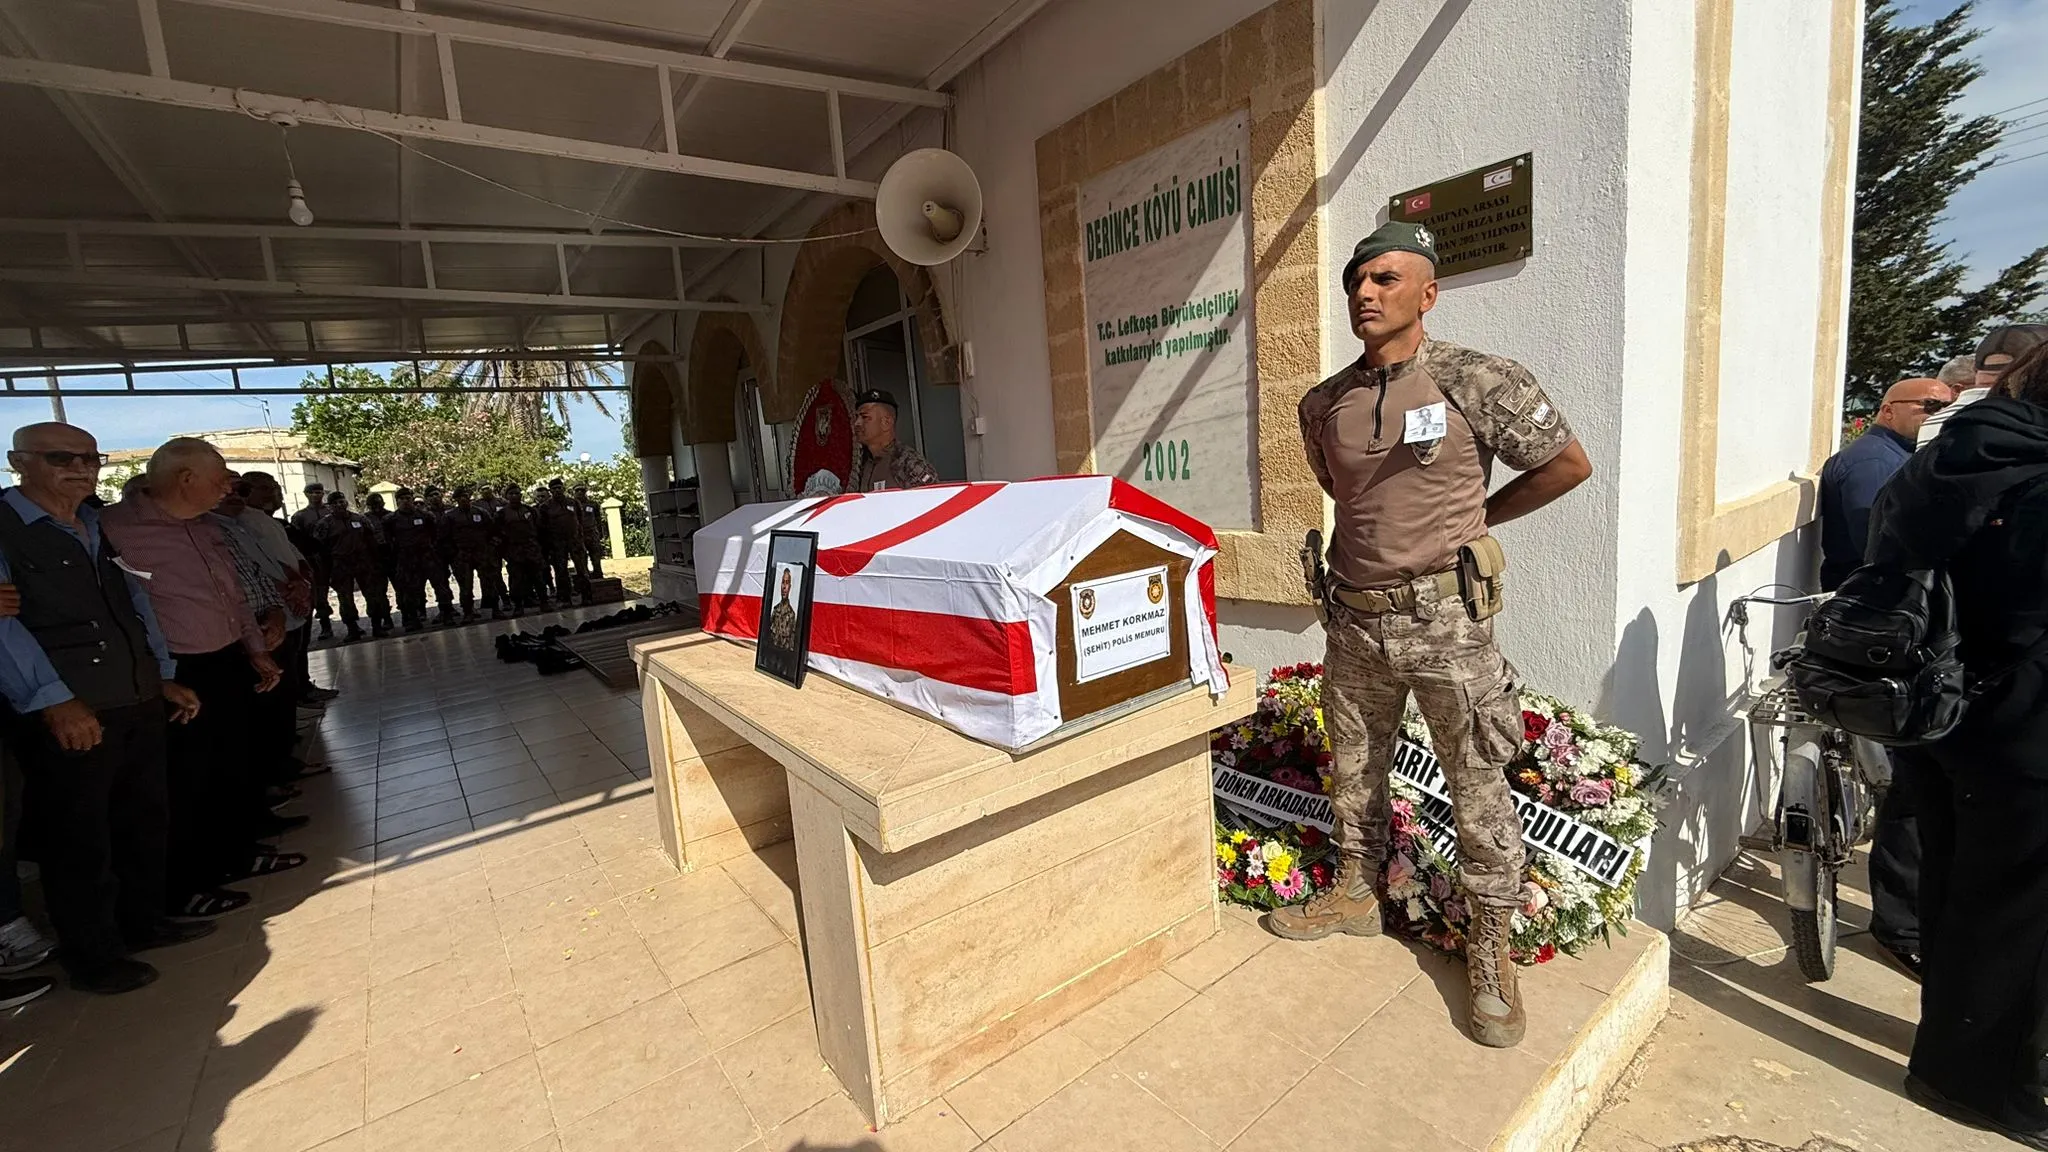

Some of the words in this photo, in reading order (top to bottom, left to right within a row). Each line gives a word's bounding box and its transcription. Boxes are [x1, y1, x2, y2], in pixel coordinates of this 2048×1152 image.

[1086, 201, 1140, 262] DERİNCE
[1143, 175, 1181, 243] KÖYÜ
[1187, 149, 1242, 229] CAMİSİ
[1097, 322, 1115, 341] T.C.
[1118, 313, 1158, 337] Lefkoşa
[1161, 289, 1239, 328] Büyükelçiliği
[1105, 338, 1162, 366] katkılarıyla
[1165, 327, 1231, 359] yapılmıştır.
[1143, 439, 1190, 481] 2002
[1081, 619, 1121, 637] MEHMET
[1122, 608, 1165, 627] KORKMAZ
[1083, 641, 1111, 657] (ŞEHİT)
[1112, 634, 1133, 648] POLİS
[1134, 626, 1165, 641] MEMURU
[1215, 770, 1261, 801] DÖNEM
